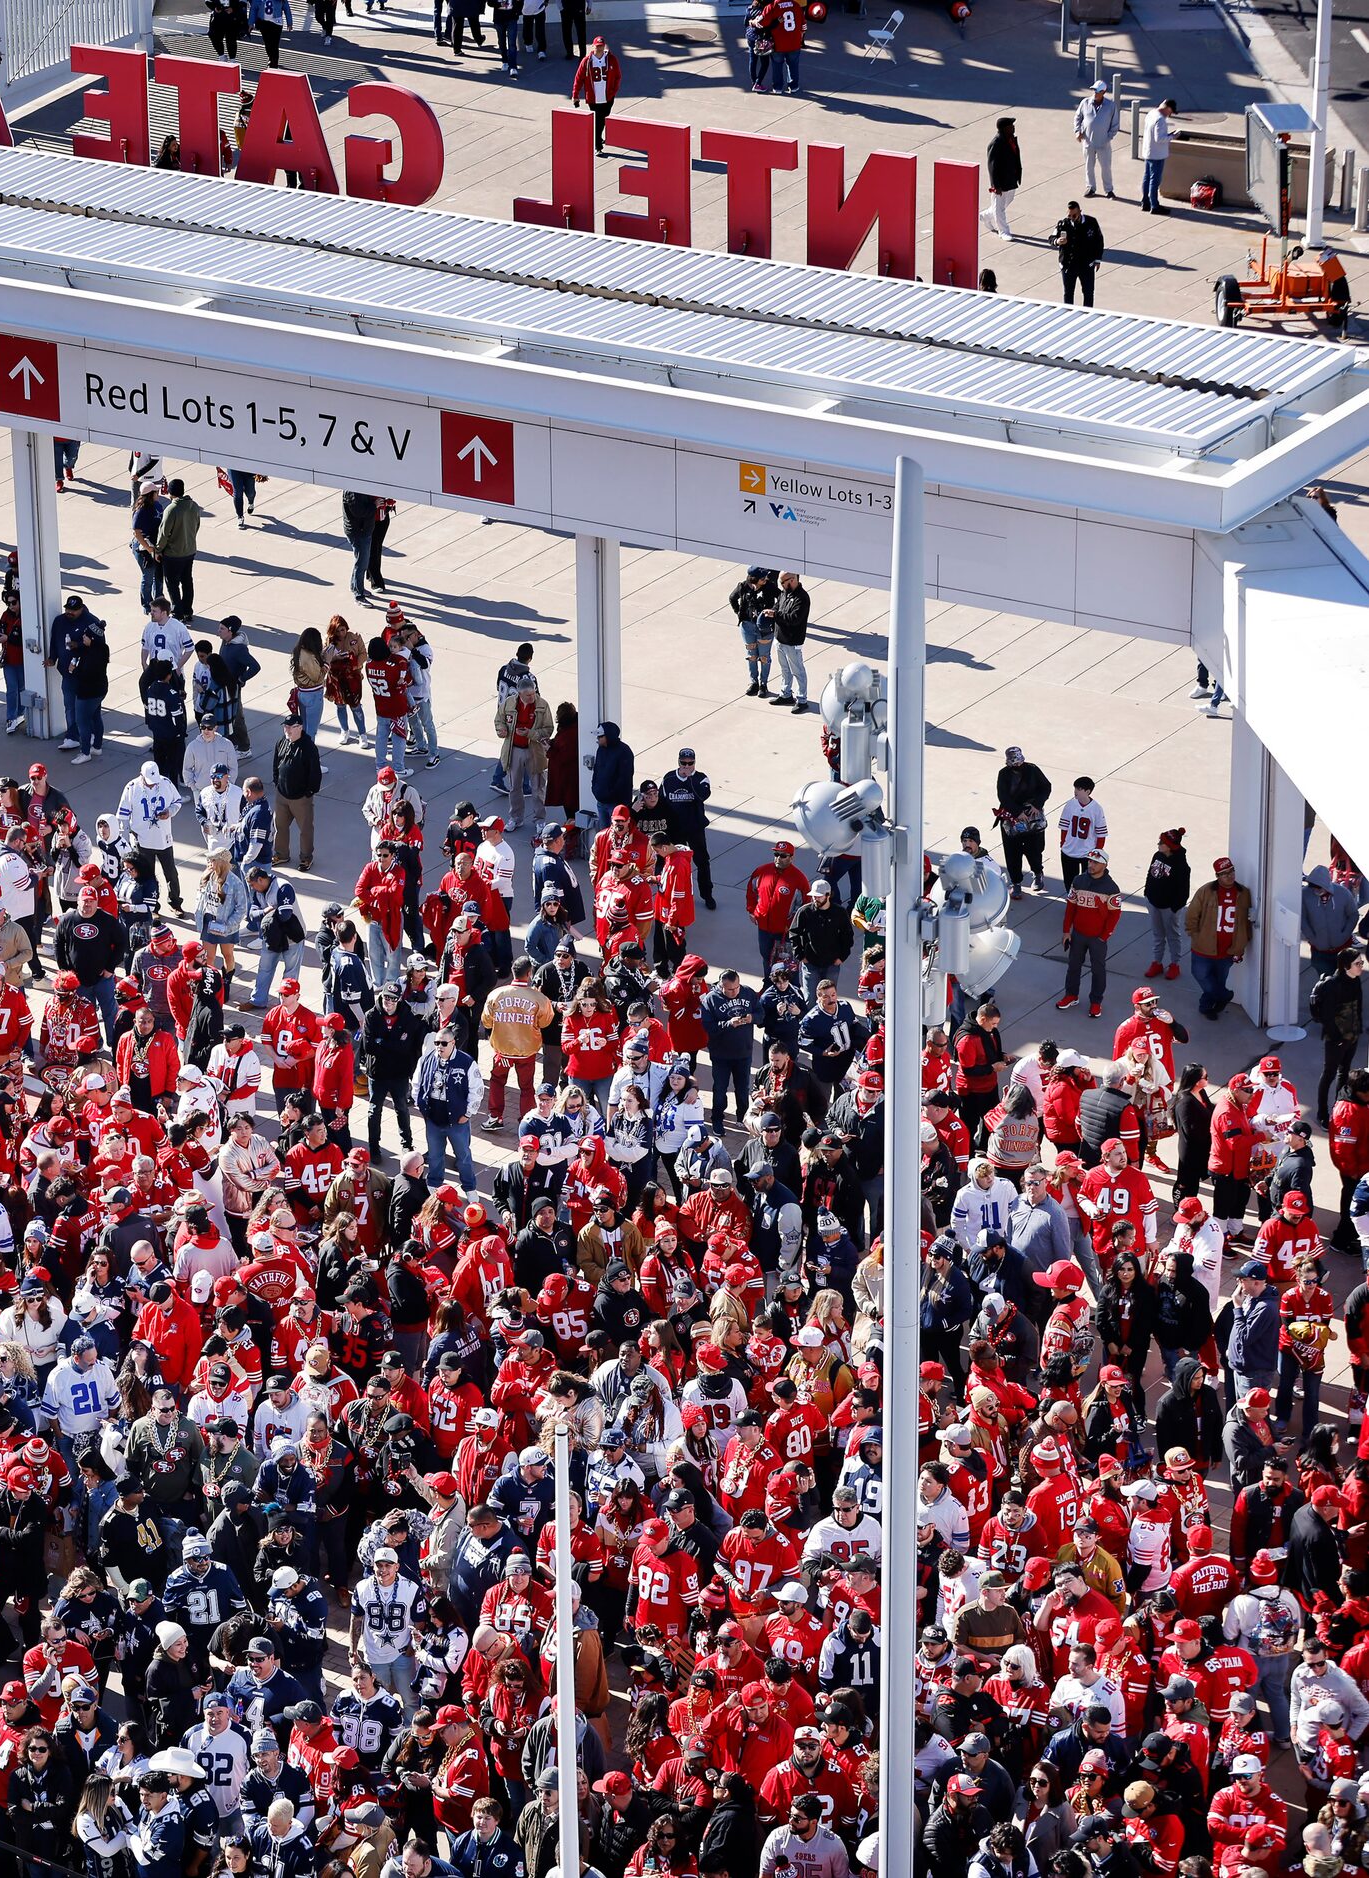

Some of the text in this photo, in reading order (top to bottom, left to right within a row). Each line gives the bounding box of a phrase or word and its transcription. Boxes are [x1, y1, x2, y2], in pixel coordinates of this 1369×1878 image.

[781, 11, 796, 32] 8
[85, 372, 149, 415] Red
[162, 385, 235, 430] Lots
[318, 413, 338, 447] 7
[350, 420, 376, 455] &
[387, 425, 411, 461] V
[771, 475, 892, 510] Yellow Lots 1-3
[371, 679, 391, 698] 52
[140, 797, 163, 819] 12
[1071, 816, 1091, 839] 19
[495, 1012, 534, 1024] NINERS
[499, 997, 536, 1014] FORTY
[719, 999, 750, 1013] COWBOYS
[278, 1031, 293, 1055] 8
[832, 1022, 850, 1050] 11
[301, 1164, 332, 1192] 42
[355, 1200, 369, 1224] 7
[1097, 1188, 1128, 1214] 49
[981, 1202, 1002, 1228] 11
[1209, 1224, 1220, 1232] 13
[249, 1271, 294, 1292] FAITHFUL
[553, 1313, 587, 1339] 85
[153, 1373, 163, 1384] 81
[70, 1381, 101, 1415] 21
[436, 1399, 457, 1431] 52
[702, 1404, 731, 1428] 19
[791, 1413, 804, 1427] RICE
[787, 1426, 812, 1456] 80
[965, 1478, 989, 1514] 13
[1060, 1502, 1077, 1530] 19
[137, 1519, 162, 1548] 41
[991, 1540, 1027, 1572] 23
[638, 1567, 669, 1604] 82
[734, 1560, 772, 1588] 97
[1191, 1565, 1229, 1583] FAITHFUL
[1193, 1579, 1229, 1594] THE BAY
[188, 1590, 221, 1624] 21
[307, 1590, 321, 1602] 88
[368, 1602, 410, 1631] 88
[1053, 1619, 1078, 1647] 54
[772, 1638, 803, 1660] 49
[1134, 1654, 1147, 1665] 10
[850, 1652, 873, 1684] 11
[1205, 1658, 1221, 1672] 85
[1102, 1683, 1115, 1694] 10
[247, 1698, 264, 1730] 4
[340, 1720, 382, 1752] 88
[1182, 1722, 1197, 1734] 23
[199, 1752, 232, 1785] 82
